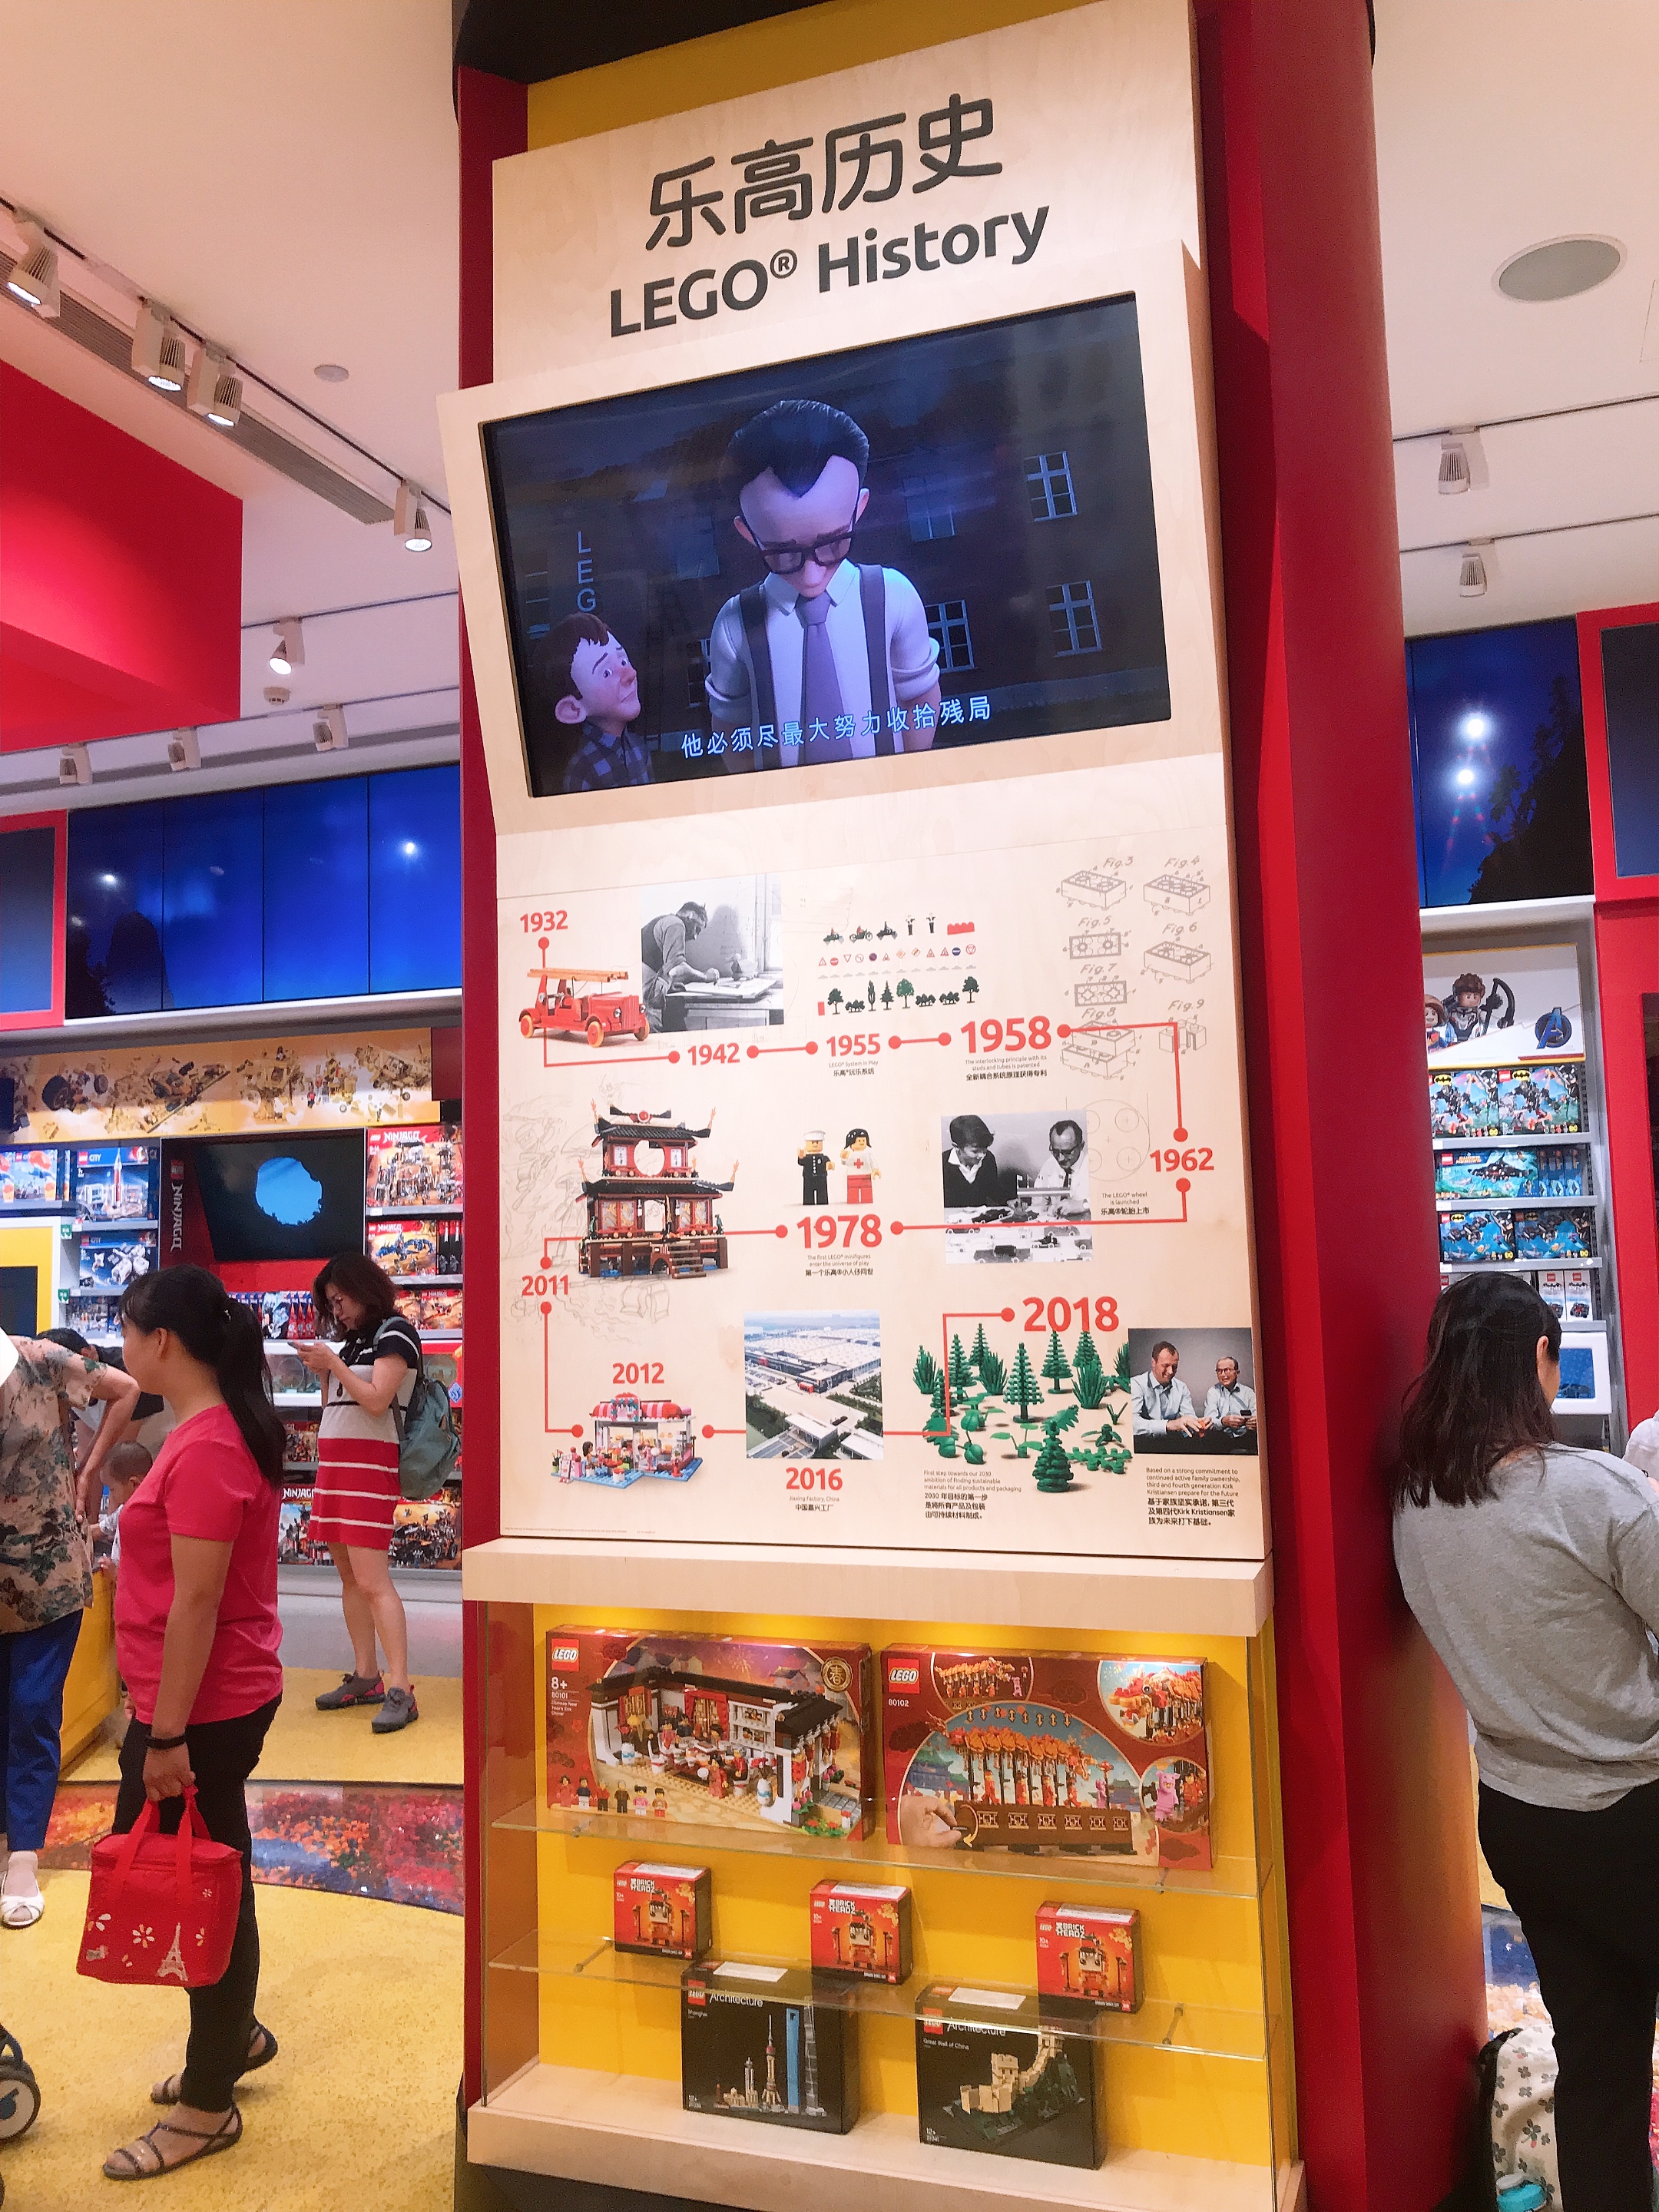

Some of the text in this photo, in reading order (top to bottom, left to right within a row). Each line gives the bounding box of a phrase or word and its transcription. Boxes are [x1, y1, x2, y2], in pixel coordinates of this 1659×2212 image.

[645, 92, 1002, 251] 乐高历史
[610, 205, 1050, 338] LEGO® History
[680, 695, 991, 760] 他必须尽最大努力收拾残局
[519, 909, 569, 933] 1932
[826, 1032, 881, 1057] 1955
[960, 1015, 1052, 1054] 1958
[687, 1042, 741, 1066] 1942
[975, 1057, 1005, 1065] interlocking
[1149, 1147, 1214, 1173] 1962
[170, 1182, 184, 1253] NINJAGO
[796, 1214, 882, 1249] 1978
[522, 1274, 569, 1296] 2011
[1022, 1296, 1120, 1333] 2018
[612, 1362, 665, 1385] 2012
[785, 1466, 843, 1491] 2016
[553, 1647, 578, 1661] LEGO
[551, 1676, 568, 1690] 8+
[890, 1668, 918, 1683] LEGO
[888, 1698, 909, 1707] 80102
[835, 1899, 856, 1907] BRICK
[922, 2037, 937, 2046] Great
[955, 2041, 970, 2051] China
